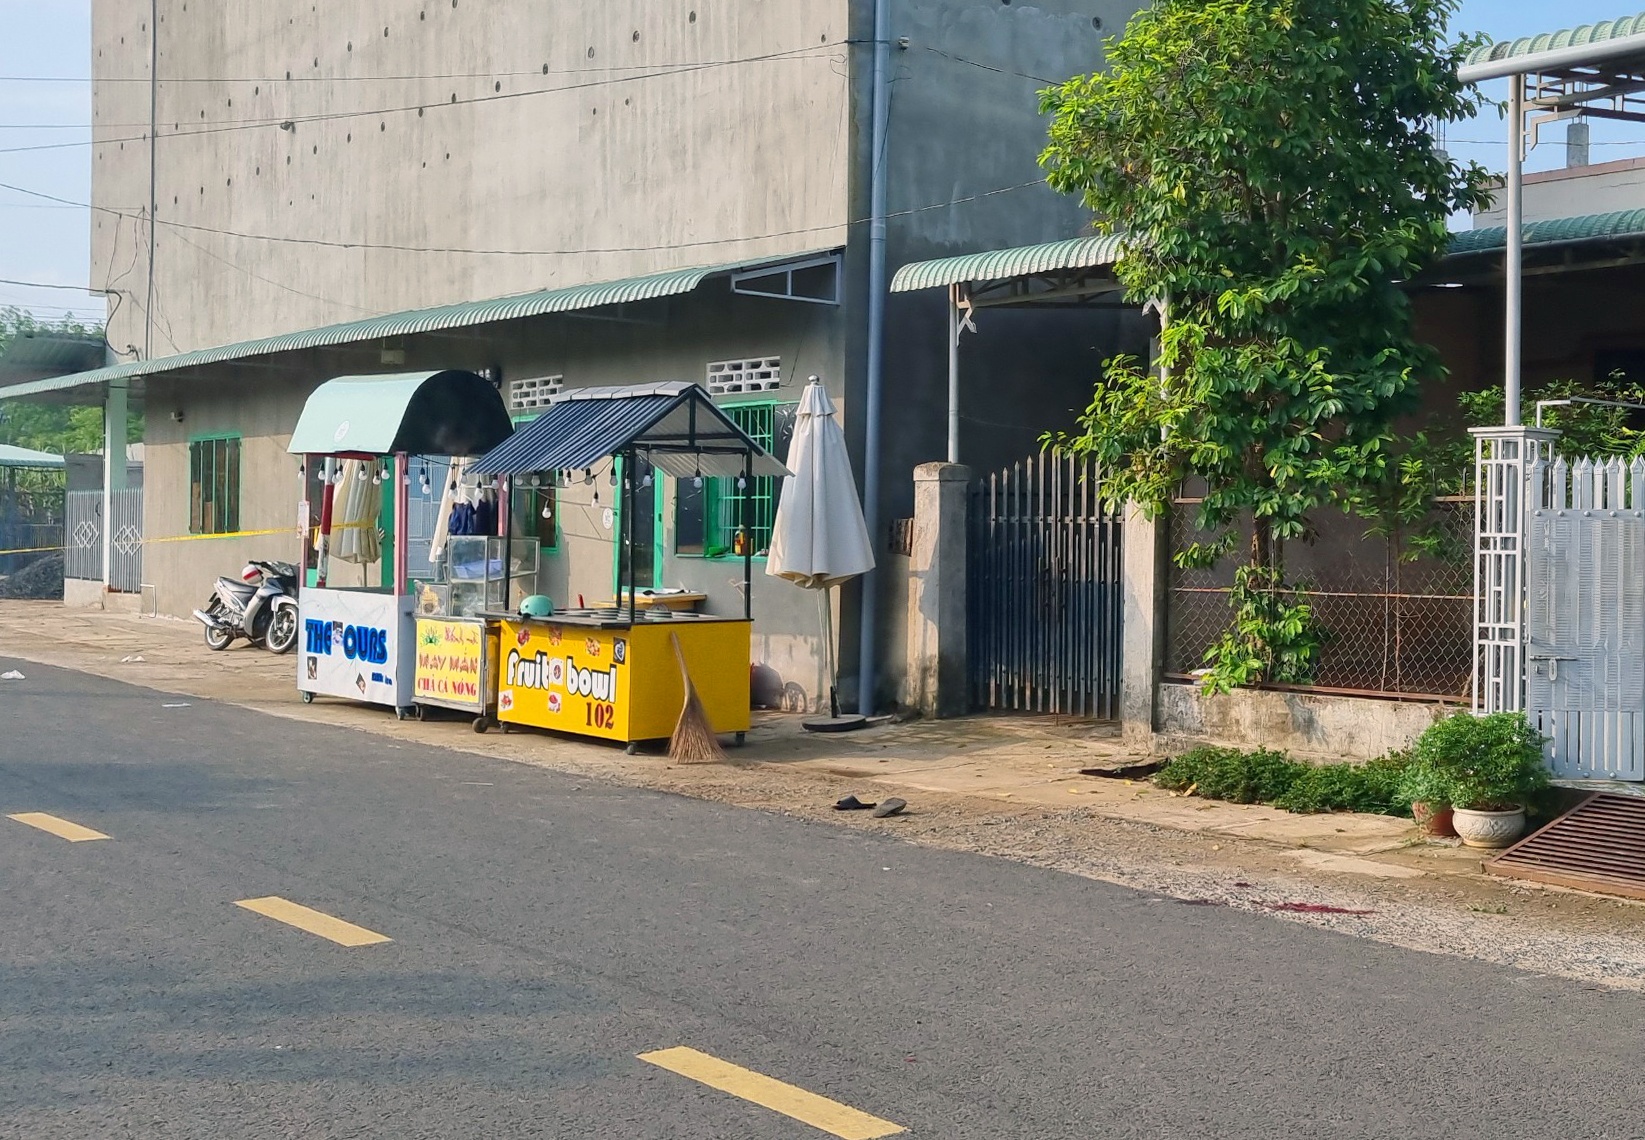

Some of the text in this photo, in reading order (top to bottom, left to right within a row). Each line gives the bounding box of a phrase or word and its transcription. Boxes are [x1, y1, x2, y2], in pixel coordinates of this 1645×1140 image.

[305, 618, 333, 656] THE
[566, 655, 617, 704] bowl
[585, 702, 615, 730] 102
